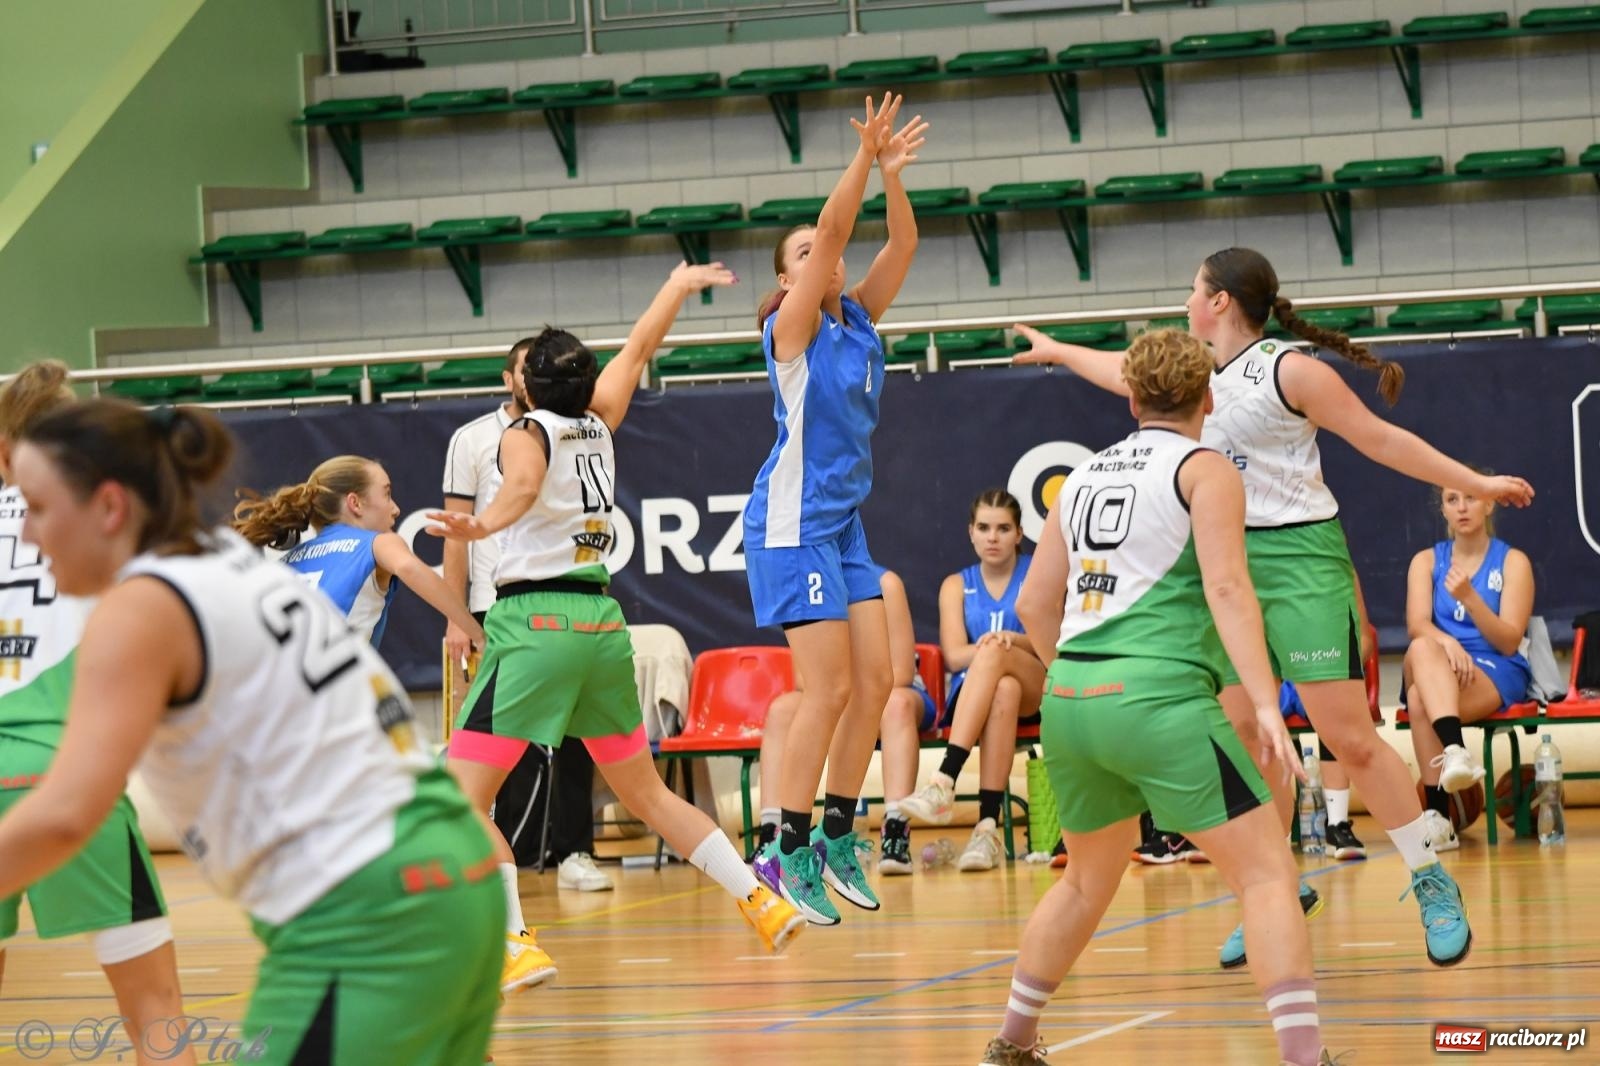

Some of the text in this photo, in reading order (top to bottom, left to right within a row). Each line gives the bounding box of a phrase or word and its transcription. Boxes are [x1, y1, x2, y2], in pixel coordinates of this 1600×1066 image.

[1243, 361, 1265, 385] 4
[575, 453, 612, 513] 11
[1070, 484, 1136, 552] 10
[808, 572, 823, 605] 2
[990, 610, 1005, 632] 11
[0, 637, 36, 657] GET
[258, 587, 359, 693] 2
